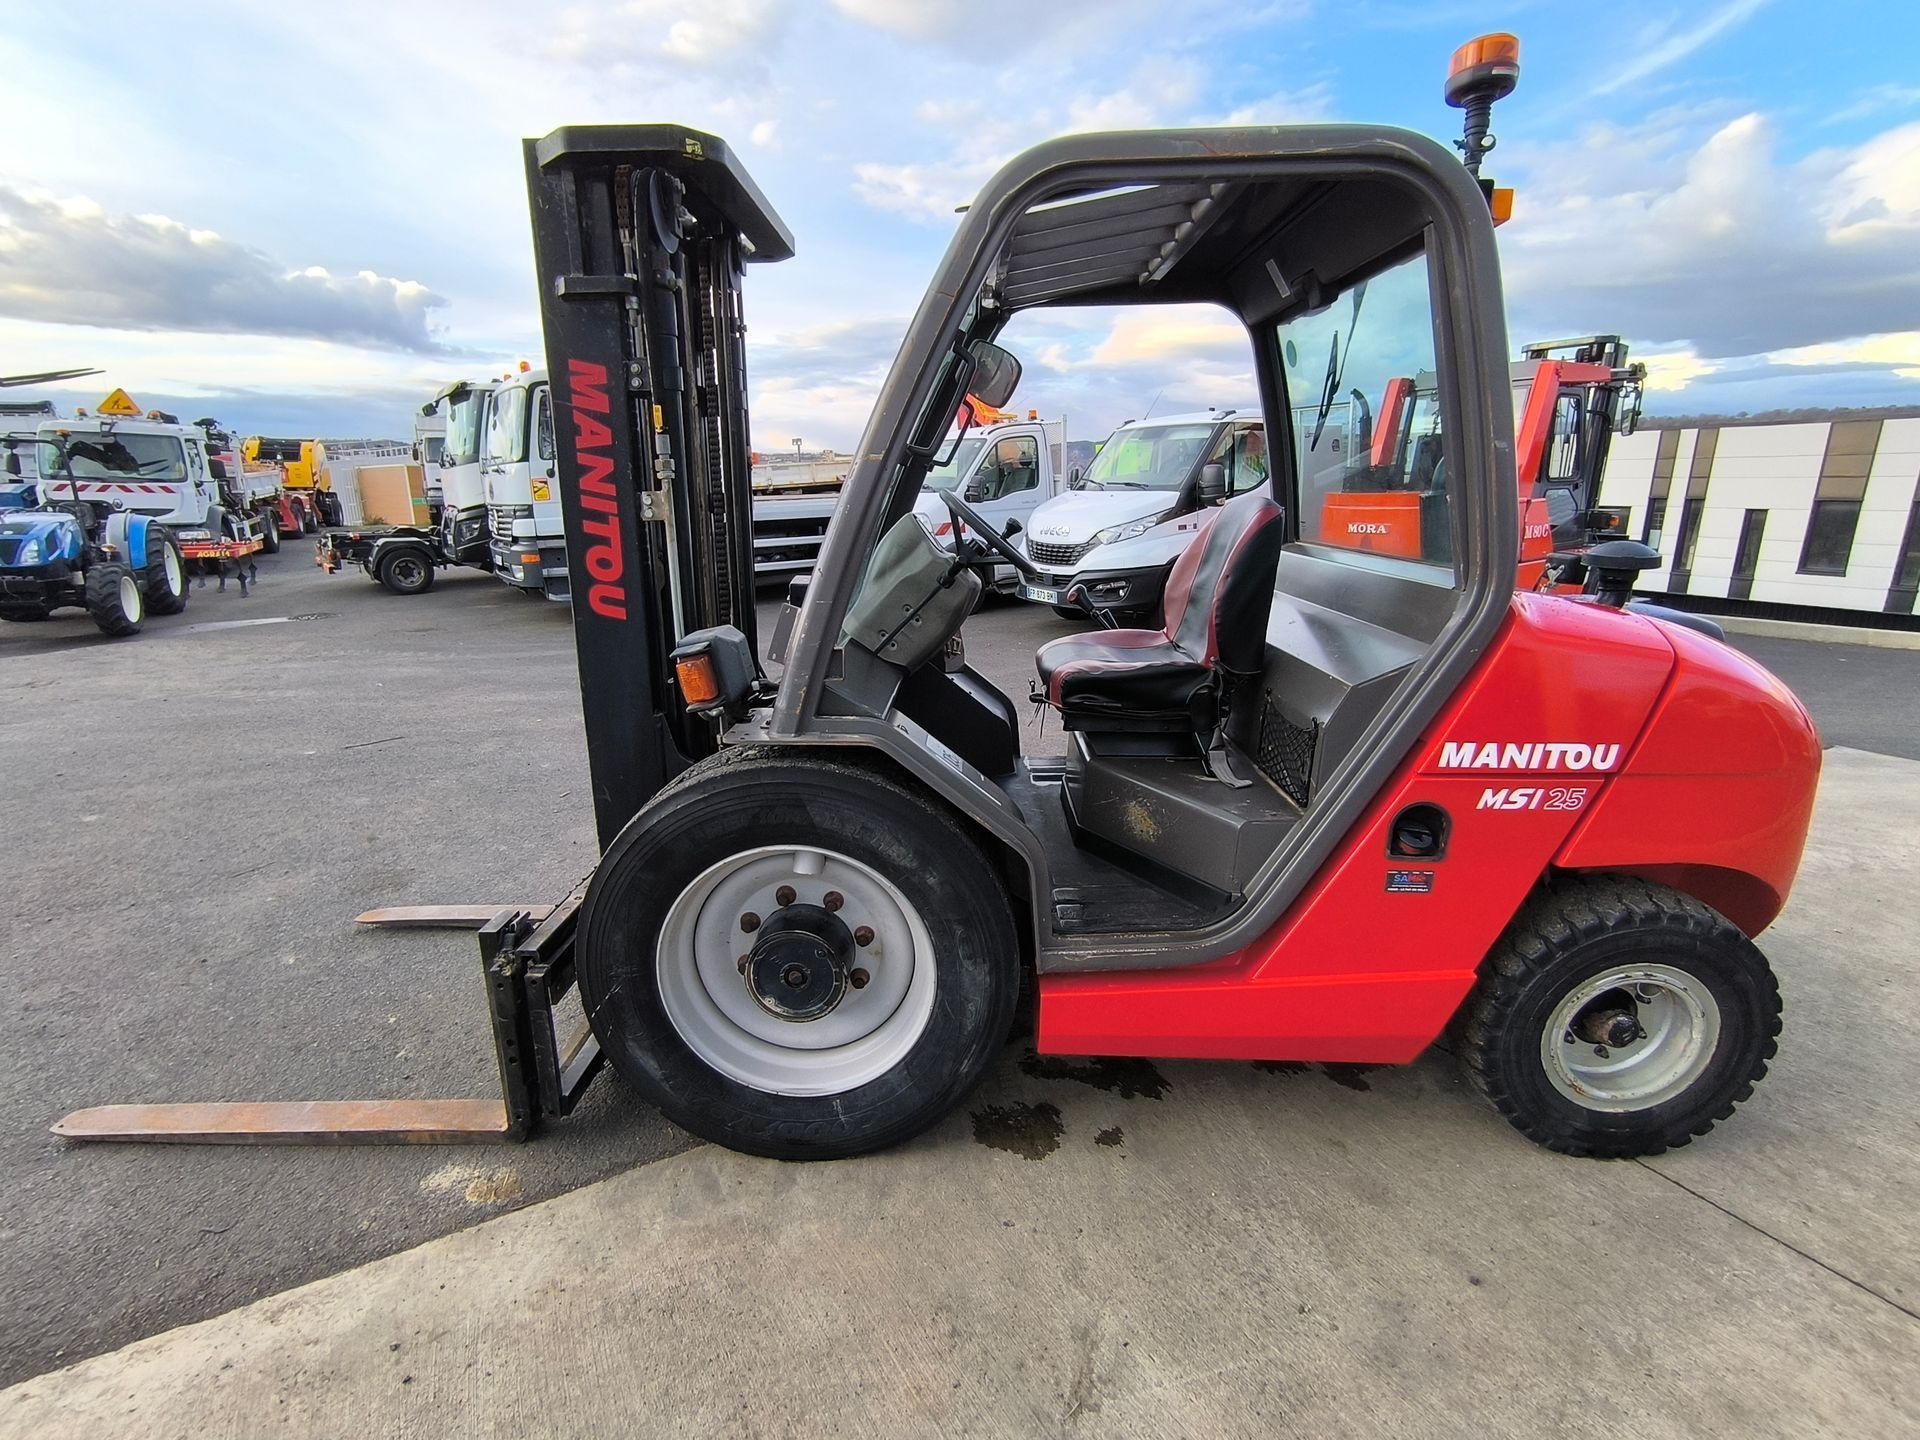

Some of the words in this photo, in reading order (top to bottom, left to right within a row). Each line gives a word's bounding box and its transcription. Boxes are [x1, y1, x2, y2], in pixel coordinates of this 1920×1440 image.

[568, 358, 627, 620] MANITOU
[1040, 526, 1071, 537] IVECO
[1347, 523, 1387, 534] MORA
[1438, 742, 1620, 770] MANITOU
[1476, 788, 1545, 810] MSI
[1544, 788, 1587, 810] 25
